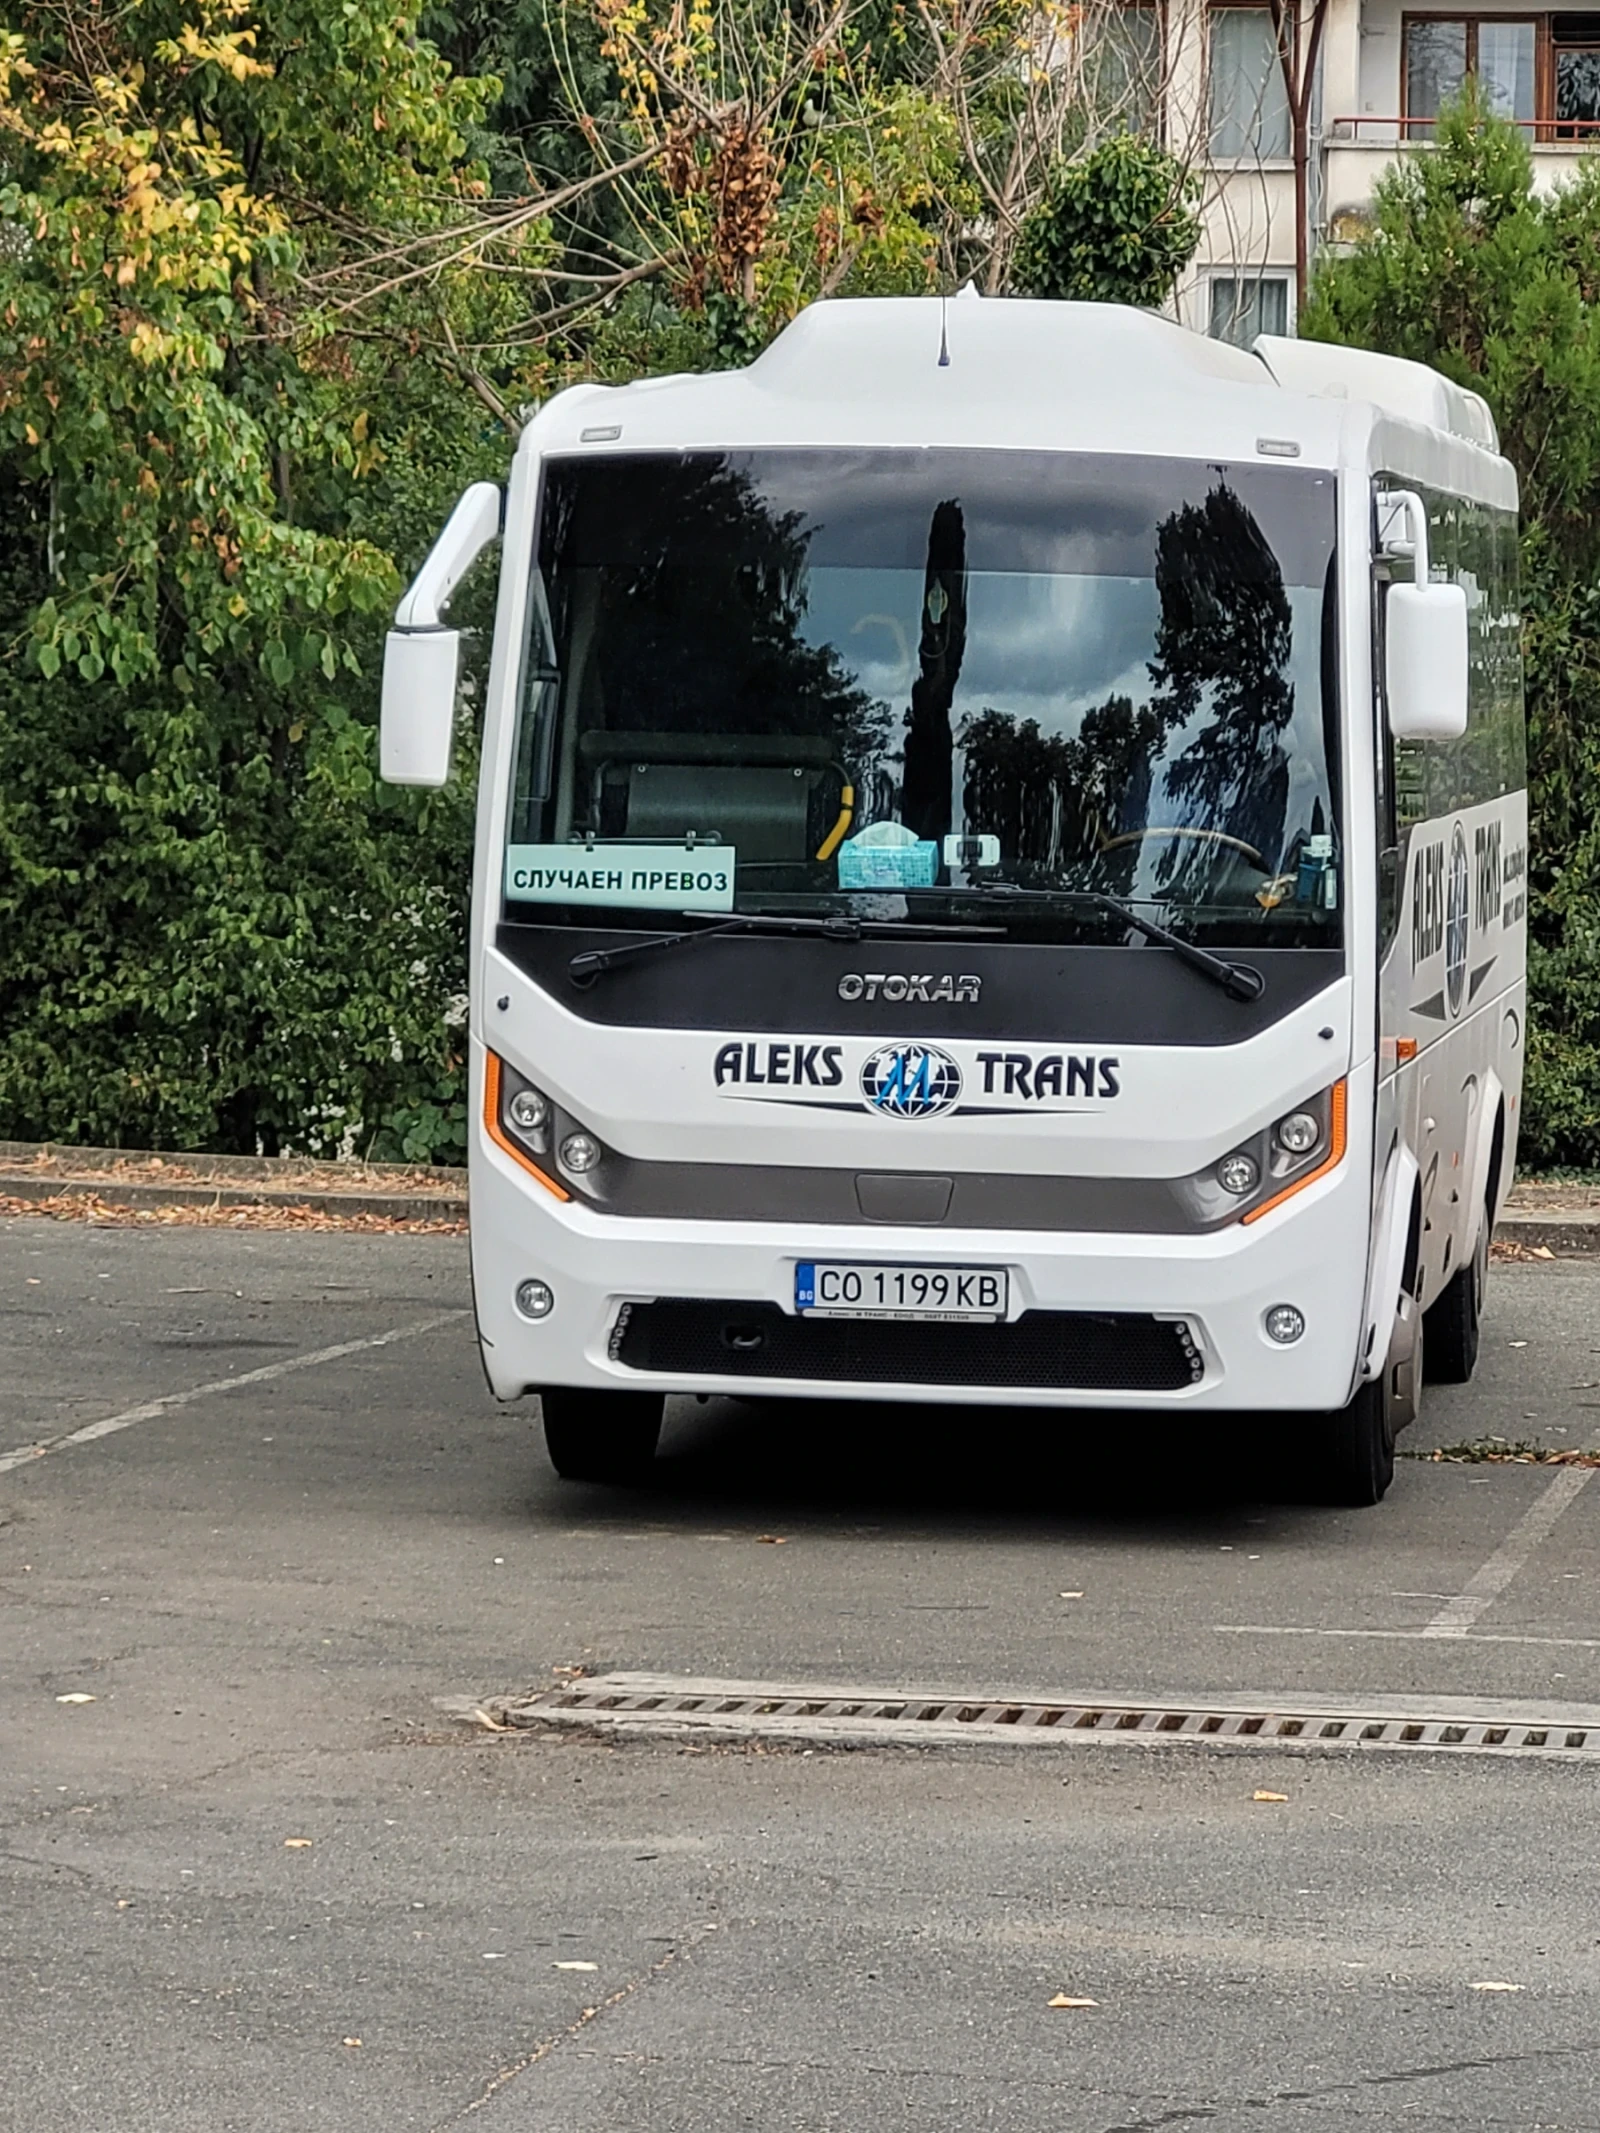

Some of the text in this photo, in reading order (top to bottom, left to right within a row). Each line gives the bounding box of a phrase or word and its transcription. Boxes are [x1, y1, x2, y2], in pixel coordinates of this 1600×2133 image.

[513, 869, 728, 892] СЛУЧАЕН ПРЕВОЗ
[837, 973, 982, 1003] OTOKAR
[713, 1042, 843, 1087] ALEKS
[976, 1051, 1120, 1101] TRANS
[798, 1290, 813, 1301] BG
[820, 1271, 999, 1307] CO 1199 KB
